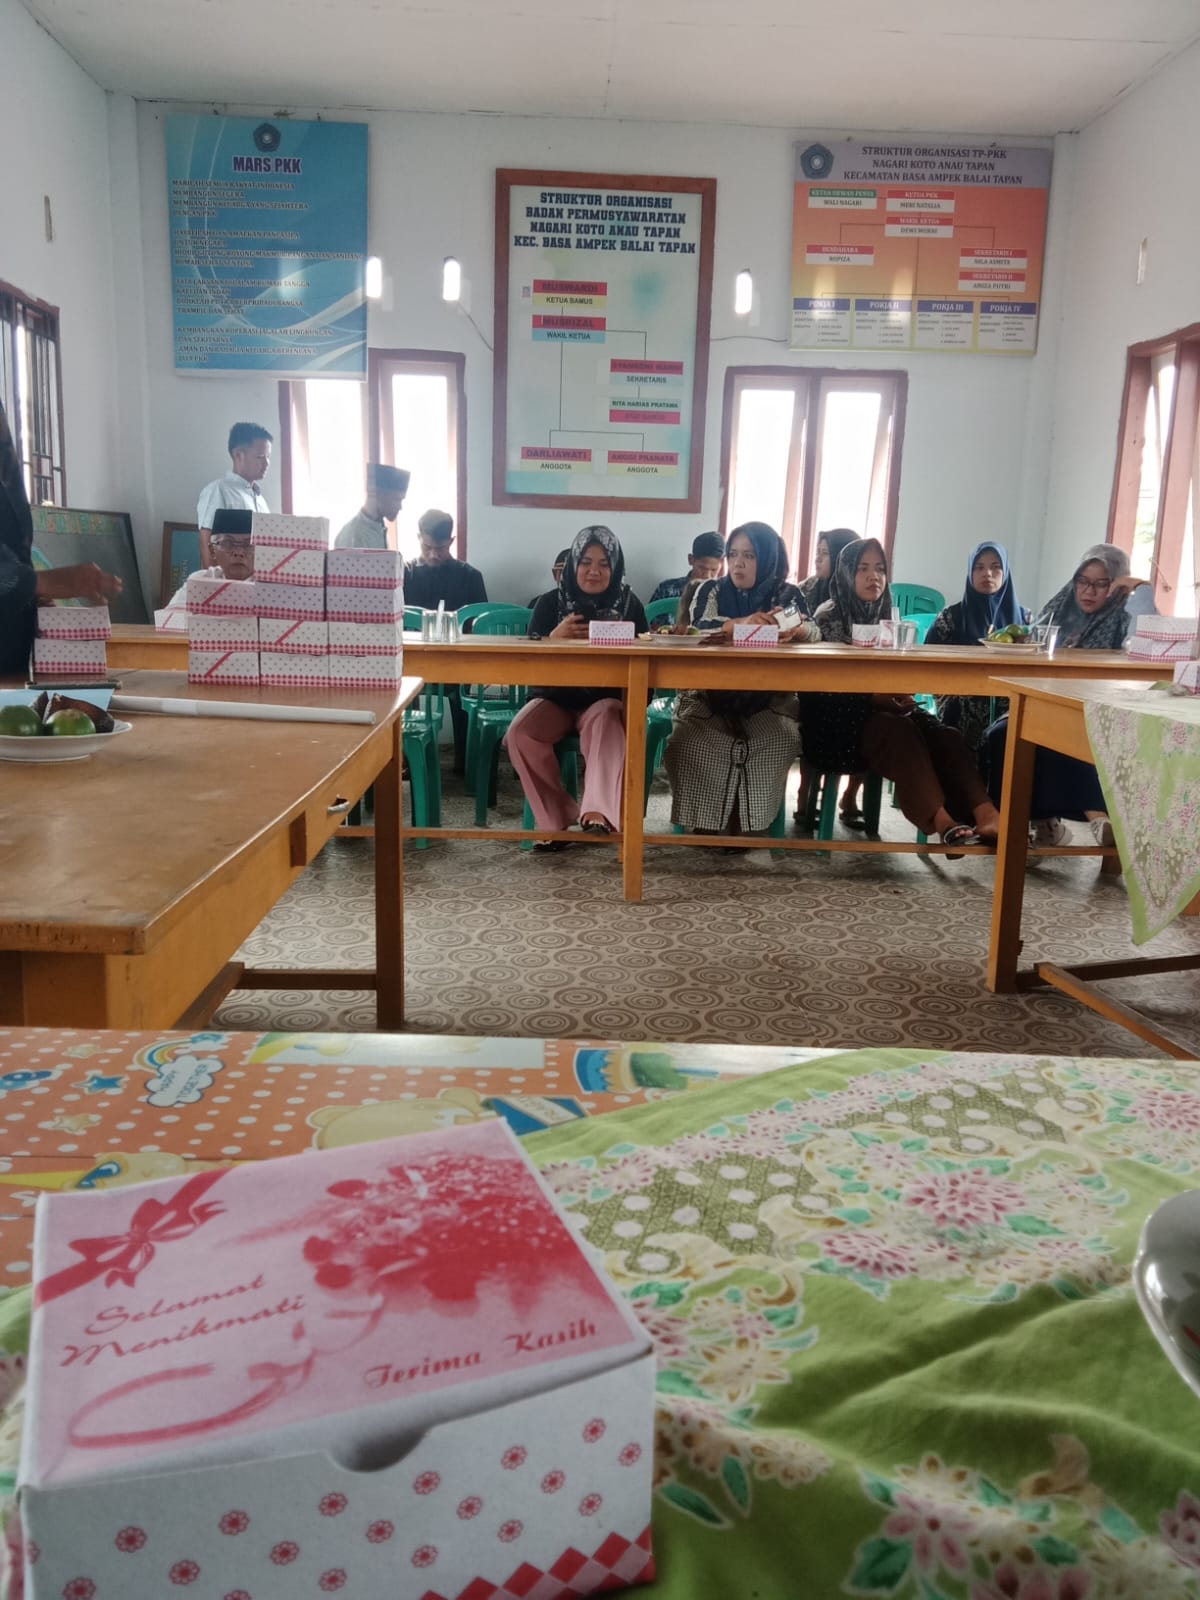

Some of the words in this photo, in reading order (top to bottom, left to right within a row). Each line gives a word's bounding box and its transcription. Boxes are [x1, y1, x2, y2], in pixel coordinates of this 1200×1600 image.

[862, 146, 913, 156] STRUKTUR
[914, 147, 970, 158] ORGANISASI
[971, 149, 1008, 159] TP-PKK
[232, 156, 271, 172] MARS
[274, 158, 302, 174] PKK
[872, 159, 908, 169] NAGARI
[910, 160, 936, 169] KOTO
[937, 160, 965, 170] ANAU
[966, 161, 995, 171] TAPAN
[843, 171, 900, 181] KECAMATAN
[902, 172, 926, 181] BASA
[927, 172, 961, 182] AMPEK
[962, 173, 991, 183] BALAI
[992, 174, 1023, 184] TAPAN
[540, 192, 602, 206] STRUKTUR
[606, 195, 673, 209] ORGANISASI
[526, 207, 564, 219] BADAN
[567, 208, 686, 224] PERMUSYAWARATAN
[530, 222, 572, 234] NAGARI
[576, 224, 604, 235] KOTO
[608, 225, 639, 237] ANAU
[643, 226, 681, 238] TAPAN
[514, 236, 539, 247] KEC.
[542, 237, 571, 249] BASA
[576, 239, 616, 251] AMPEK
[620, 240, 654, 252] BALAI
[658, 242, 696, 254] TAPAN
[869, 301, 892, 309] POKJA
[932, 303, 955, 311] POKJA
[990, 304, 1013, 312] POKJA
[626, 375, 667, 384] SEKRETARIS
[85, 1274, 265, 1336] Selamat
[60, 1294, 306, 1369] Menikmati
[363, 1349, 483, 1389] Terima
[504, 1317, 598, 1358] Kasih
